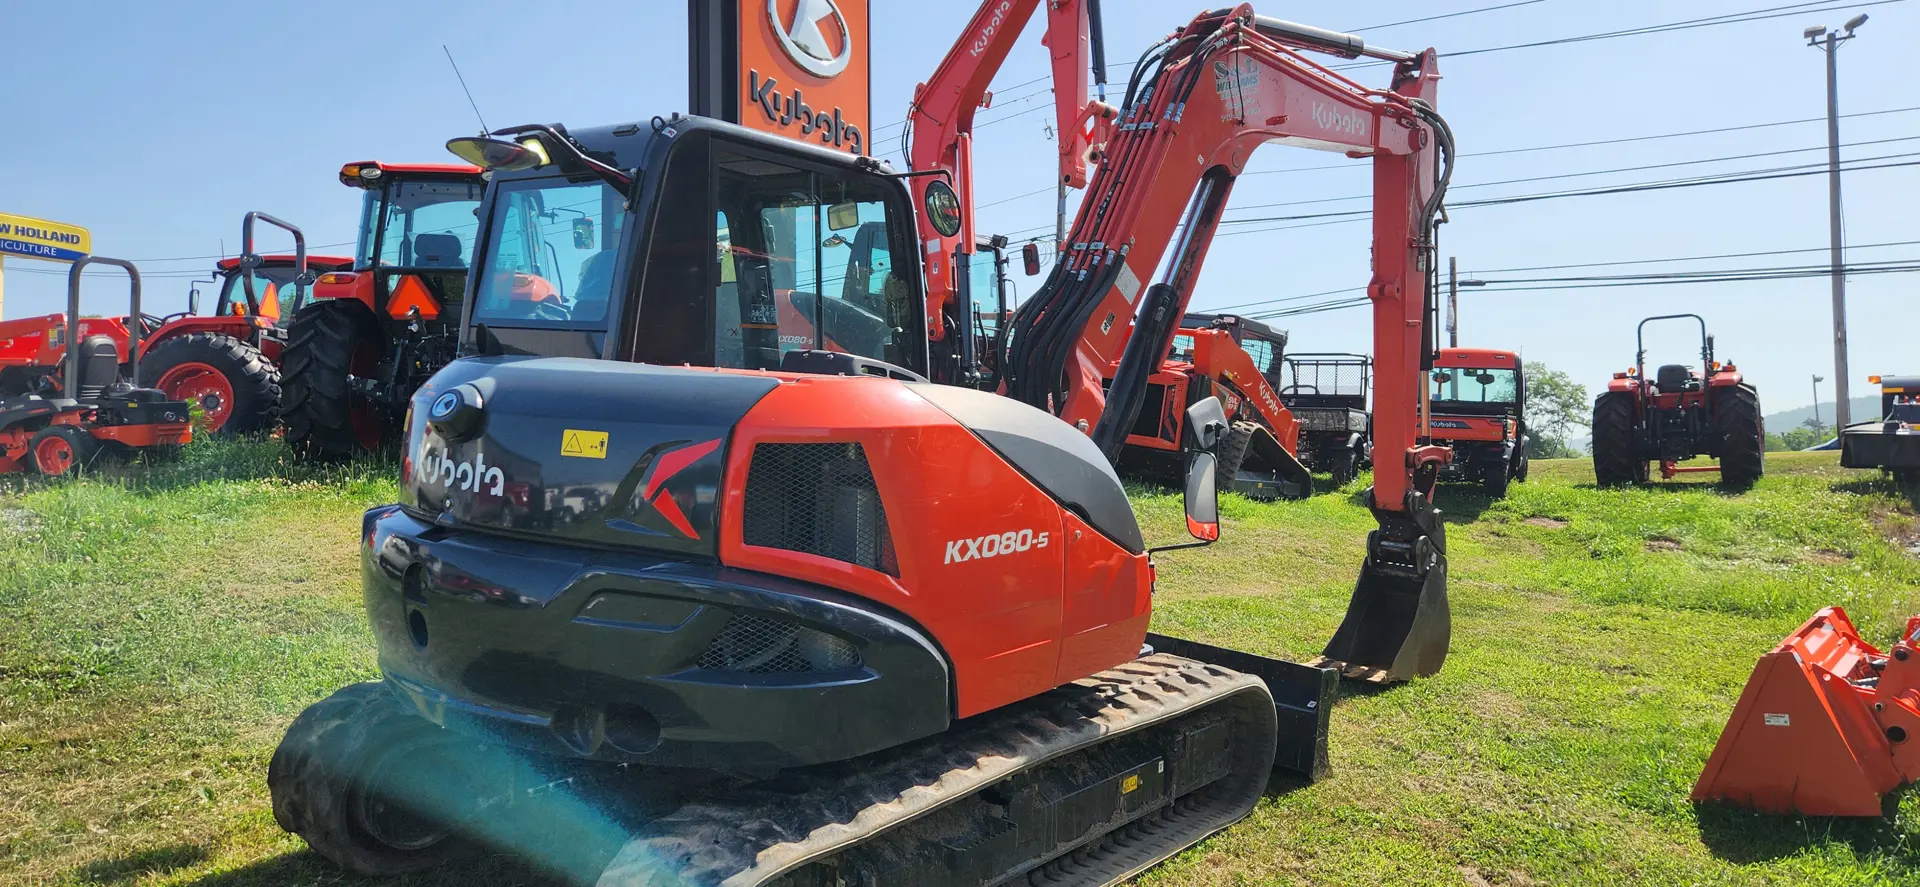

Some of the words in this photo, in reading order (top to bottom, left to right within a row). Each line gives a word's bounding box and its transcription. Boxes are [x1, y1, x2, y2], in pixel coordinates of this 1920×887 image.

[970, 1, 1010, 57] Kubota
[750, 68, 862, 155] Kubota
[1312, 101, 1365, 136] Kubota
[14, 225, 81, 245] HOLLAND
[1259, 381, 1279, 416] Kubota
[1431, 420, 1457, 428] Kubota
[414, 443, 505, 497] Kubota
[943, 528, 1049, 565] KX080-5
